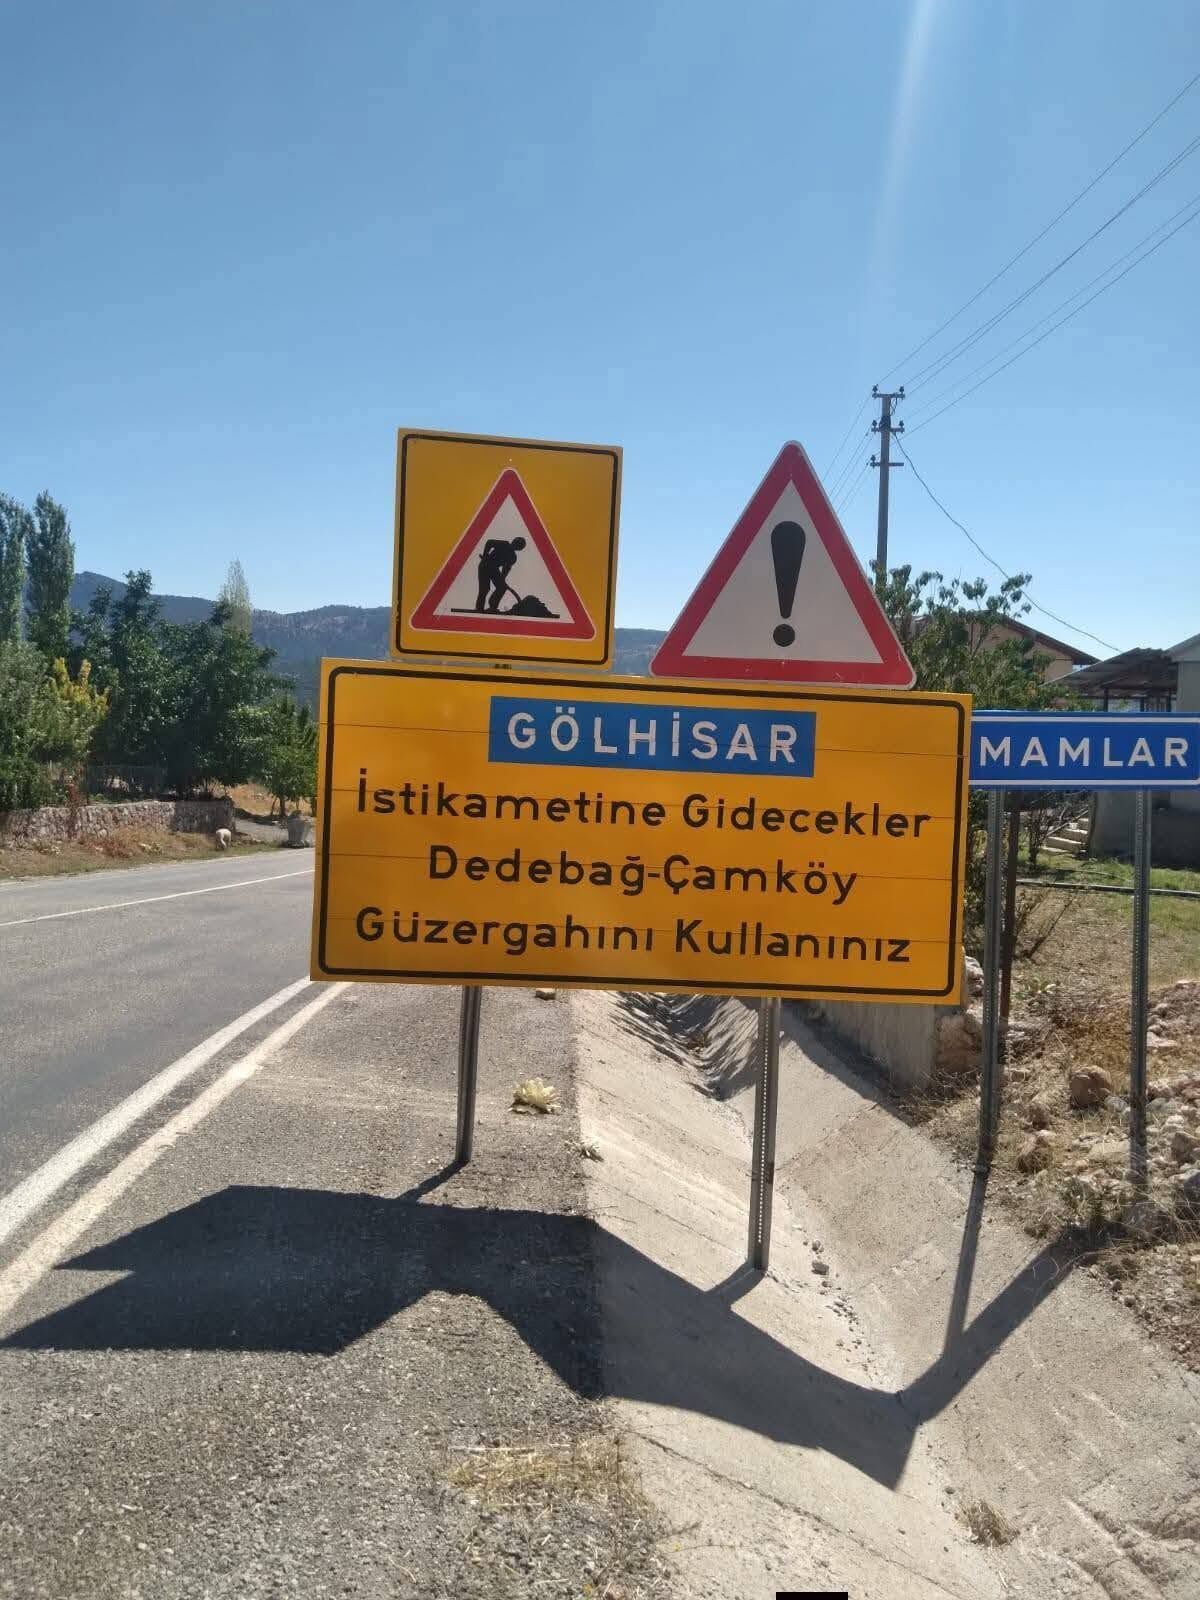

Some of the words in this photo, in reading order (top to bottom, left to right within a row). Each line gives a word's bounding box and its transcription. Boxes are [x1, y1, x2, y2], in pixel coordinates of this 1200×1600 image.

[507, 707, 798, 763] GÖLHİSAR
[979, 736, 1189, 767] MAMLAR
[357, 767, 666, 827] İstikametine
[682, 793, 932, 838] Gidecekler
[429, 844, 858, 907] Dedebağ-Çamköy
[352, 906, 654, 957] Güzergahını
[675, 918, 911, 963] Kullanınız
